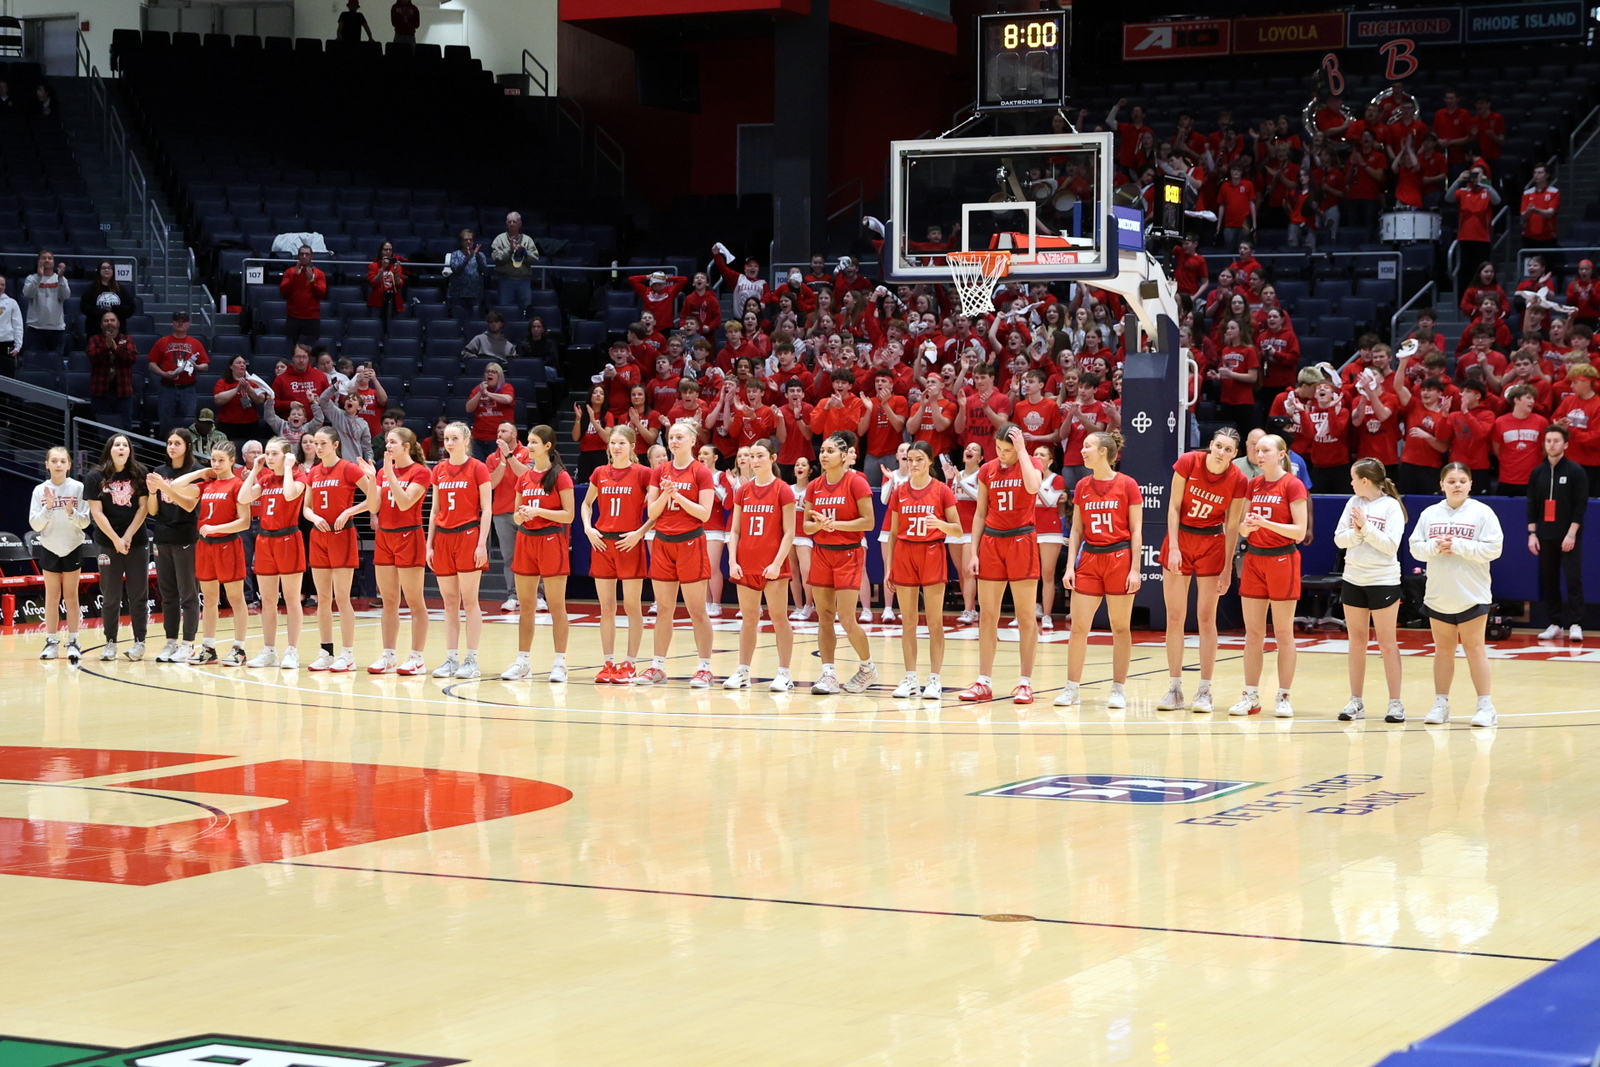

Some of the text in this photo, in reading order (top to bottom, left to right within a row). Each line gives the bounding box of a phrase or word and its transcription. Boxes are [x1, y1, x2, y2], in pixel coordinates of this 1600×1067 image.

[1358, 18, 1451, 37] RICHMOND
[1472, 12, 1576, 31] RHODE ISLAND
[1004, 21, 1057, 49] 8:00
[1258, 25, 1318, 42] LOYOLA
[1379, 38, 1418, 80] B
[1322, 53, 1345, 96] B
[117, 269, 130, 277] 107
[249, 271, 262, 279] 107
[311, 479, 339, 489] BELLEVUE
[438, 481, 469, 490] BELLEVUE
[601, 486, 633, 495] BELLEVUE
[990, 479, 1022, 489] BELLEVUE
[1138, 482, 1164, 495] mier
[202, 492, 229, 500] BELLEVUE
[319, 490, 329, 509] 3
[447, 492, 457, 511] 5
[814, 496, 846, 506] BELLEVUE
[996, 491, 1014, 512] 21
[1189, 485, 1225, 505] BELLEVUE
[1251, 495, 1282, 504] BELLEVUE
[207, 502, 215, 519] 1
[266, 498, 276, 515] 2
[610, 498, 621, 517] 11
[742, 505, 774, 514] BELLEVUE
[901, 505, 935, 514] BELLEVUE
[1084, 500, 1119, 511] BELLEVUE
[1187, 499, 1214, 519] 30
[748, 516, 764, 536] 13
[906, 517, 928, 537] 20
[1090, 513, 1114, 534] 24
[1428, 526, 1475, 538] BELLEVUE
[1175, 773, 1384, 827] FIFTH THIRD
[1306, 790, 1426, 816] BANK
